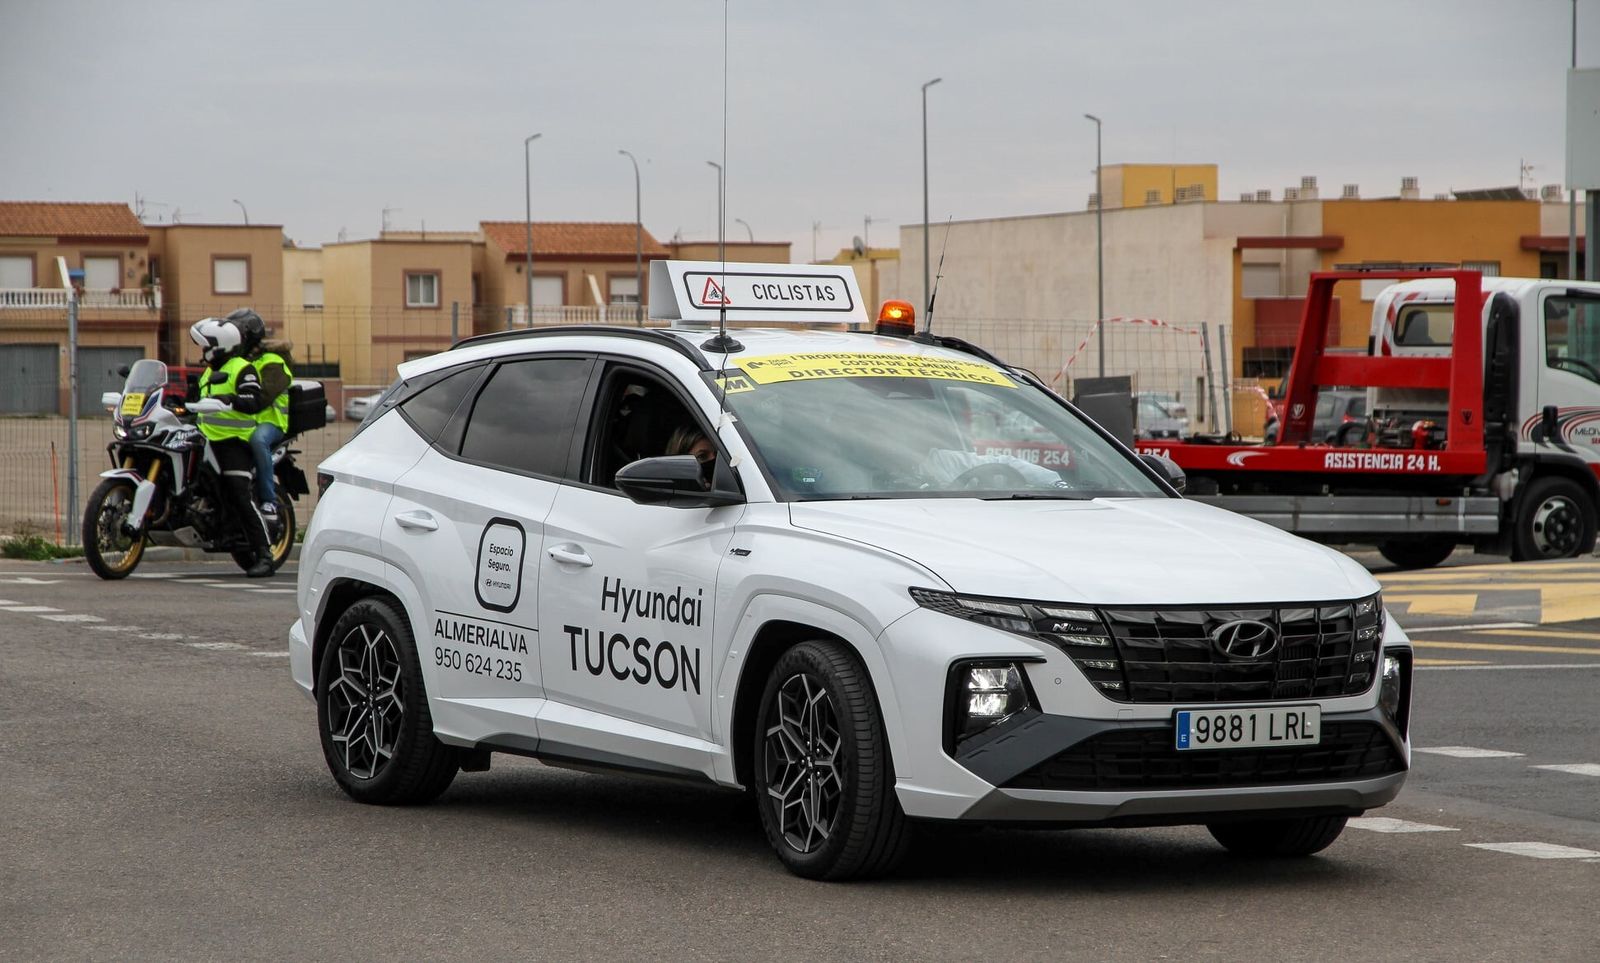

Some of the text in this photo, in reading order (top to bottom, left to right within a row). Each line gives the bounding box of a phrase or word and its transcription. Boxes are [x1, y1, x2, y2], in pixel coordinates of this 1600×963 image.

[752, 284, 836, 301] CICLISTAS
[852, 353, 905, 361] WOMEN
[788, 367, 996, 383] DIRECTOR TÉCNICO
[1043, 449, 1070, 466] 254
[1324, 452, 1441, 471] ASISTENCIA 24 H.
[489, 543, 514, 556] Espacio
[488, 558, 511, 572] Seguro.
[601, 576, 703, 626] Hyundai
[434, 618, 528, 655] ALMERIALVA
[435, 646, 522, 682] 950 624 235
[563, 624, 701, 696] TUCSON
[1196, 711, 1314, 743] 9881 LRL
[1180, 734, 1187, 743] E
